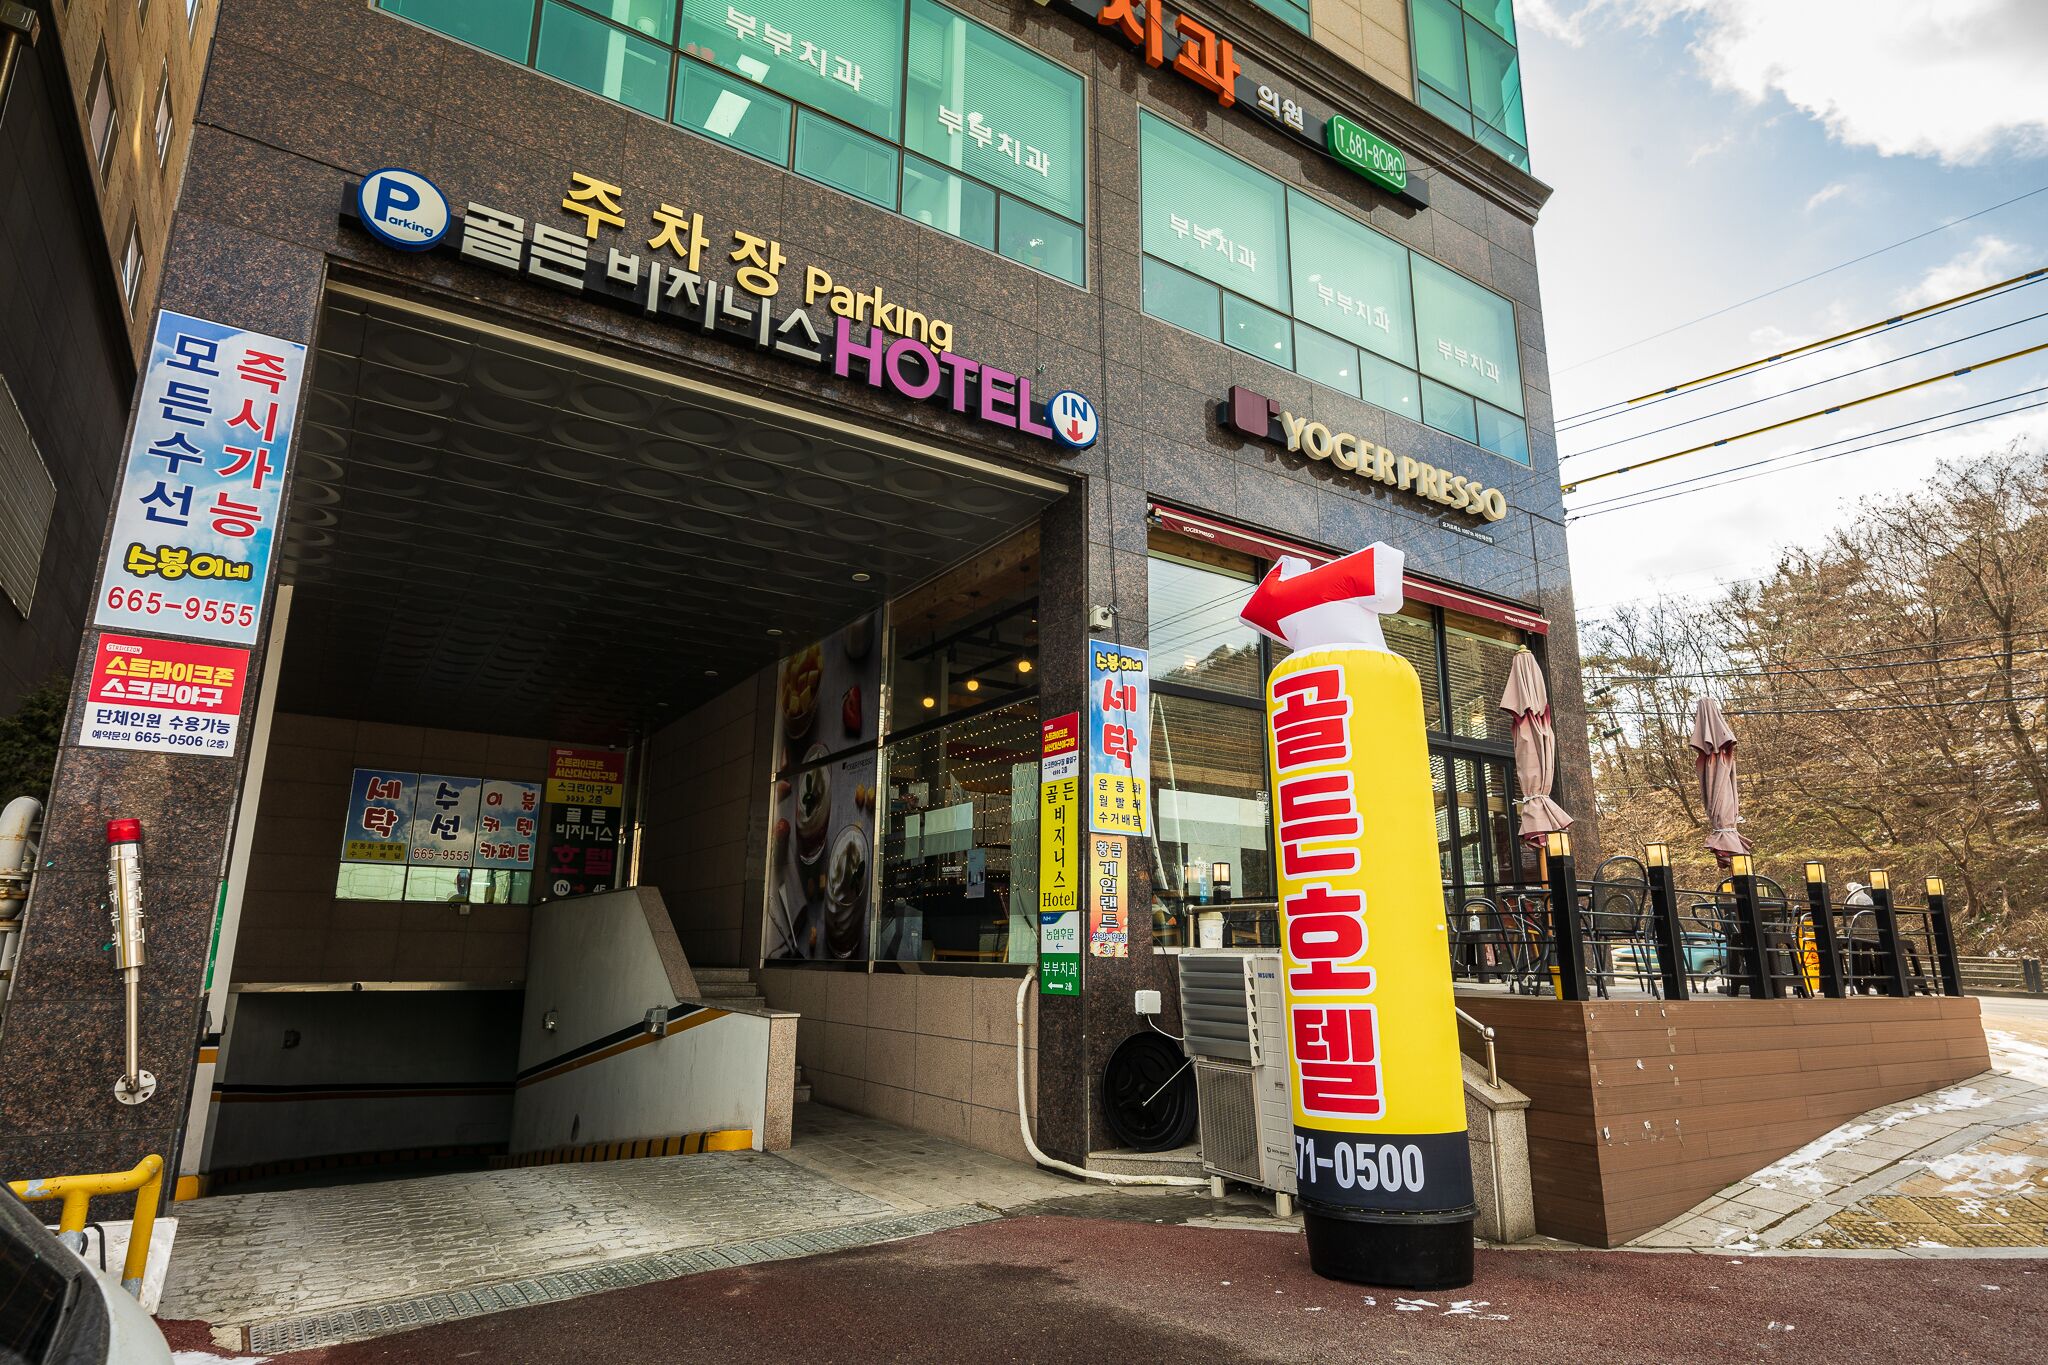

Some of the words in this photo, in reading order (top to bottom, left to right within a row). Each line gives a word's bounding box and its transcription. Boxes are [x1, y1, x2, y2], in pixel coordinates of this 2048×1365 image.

[725, 5, 864, 92] 부부치과
[1257, 84, 1304, 131] 의원
[938, 104, 1051, 177] 부부치과
[1170, 212, 1256, 273] 부부치과
[562, 171, 787, 296] 주차장
[806, 265, 953, 353] Parking
[461, 201, 589, 289] 골든
[606, 247, 821, 362] 비지니스
[835, 316, 1054, 440] HOTEL
[1316, 281, 1391, 334] 부부치과
[1436, 338, 1500, 384] 부부치과
[1062, 395, 1088, 422] IN
[123, 541, 253, 582] 수봉이네
[107, 586, 255, 628] 665-9555
[105, 655, 235, 687] 스트라이크존
[100, 678, 223, 707] 스크린야구
[96, 708, 161, 729] 단체인원
[169, 715, 231, 735] 수용가능
[1102, 678, 1138, 769] 세탁
[91, 729, 130, 741] 예약문의
[134, 731, 203, 747] 665-0506
[206, 739, 229, 749] (2층)
[362, 776, 402, 838] 세탁
[1046, 781, 1075, 804] 골든
[430, 781, 460, 841] 수선
[1099, 811, 1141, 827] 수거배달
[556, 824, 613, 841] 비지니스
[1053, 804, 1066, 888] 비지니스
[413, 848, 470, 861] 665-9555
[480, 841, 531, 862] 카페트
[551, 845, 612, 875] 호텔
[1096, 840, 1122, 858] 황금
[556, 884, 569, 892] IN
[1042, 891, 1075, 907] Hotel
[1099, 861, 1119, 928] 게임랜드
[1046, 928, 1074, 941] 농협후문
[1043, 961, 1078, 978] 부부치과
